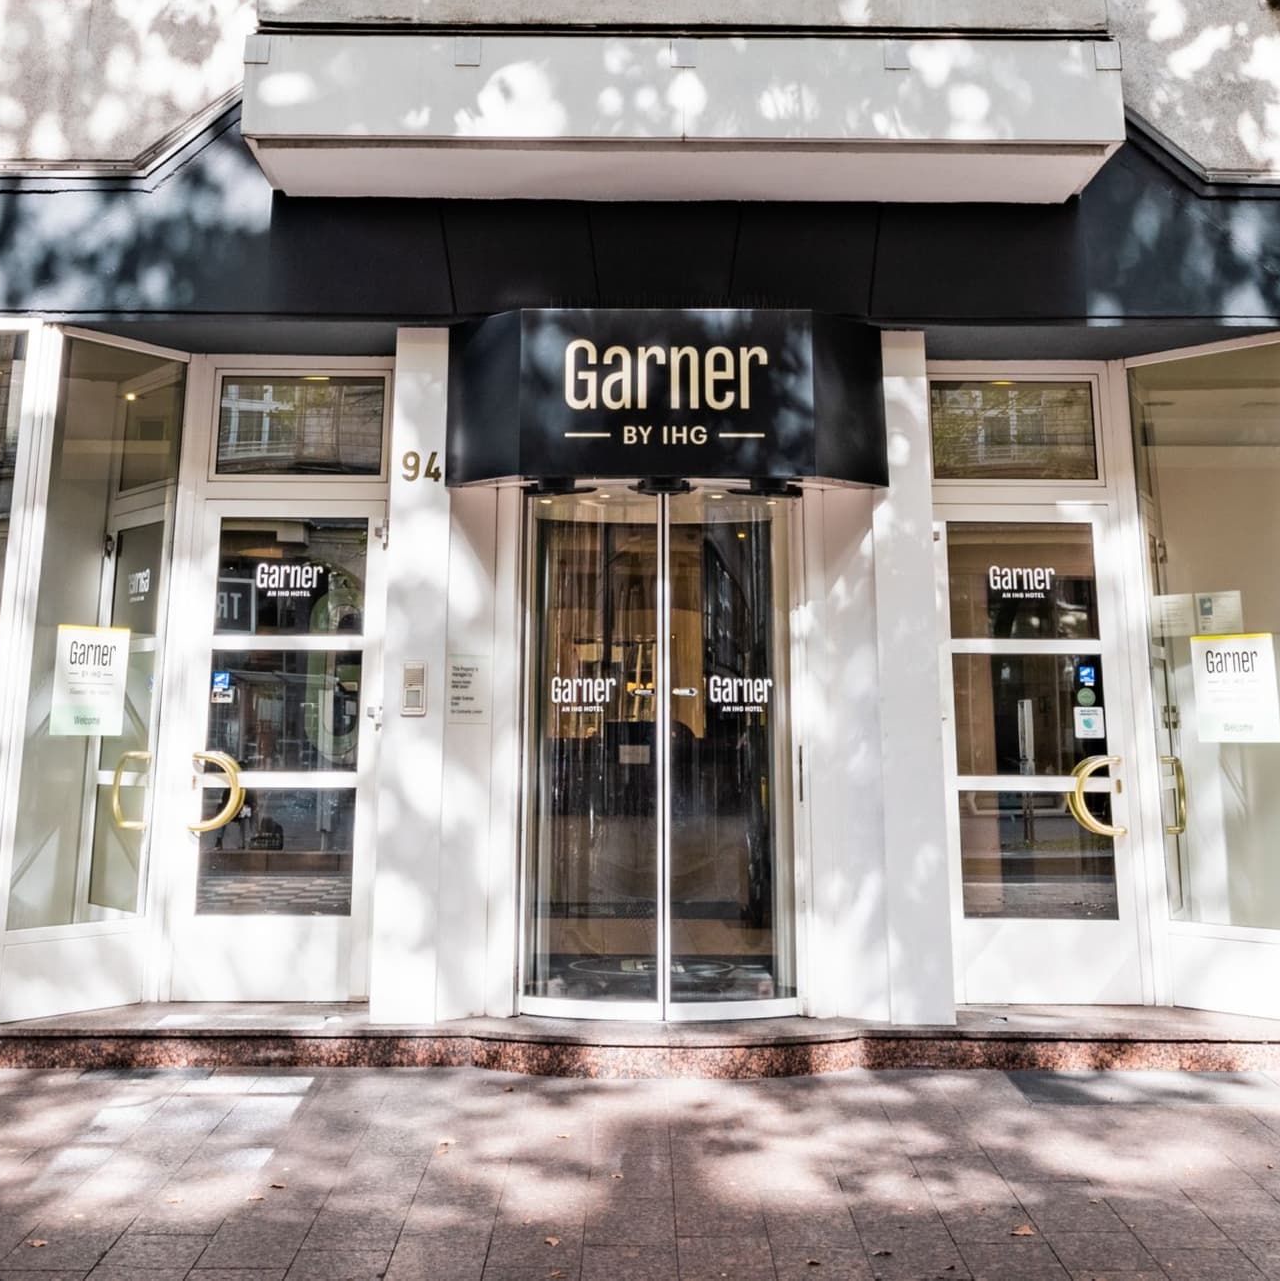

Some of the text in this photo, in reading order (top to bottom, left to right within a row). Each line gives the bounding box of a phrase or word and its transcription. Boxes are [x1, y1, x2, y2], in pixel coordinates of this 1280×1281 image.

[564, 338, 768, 411] Garner
[623, 425, 708, 445] BY IHG
[402, 450, 442, 482] 94
[256, 563, 324, 589] Garner
[988, 565, 1056, 591] Garner
[70, 640, 116, 667] Garner
[1205, 650, 1258, 674] Garner
[551, 676, 617, 703] Garner
[709, 675, 773, 703] Garner
